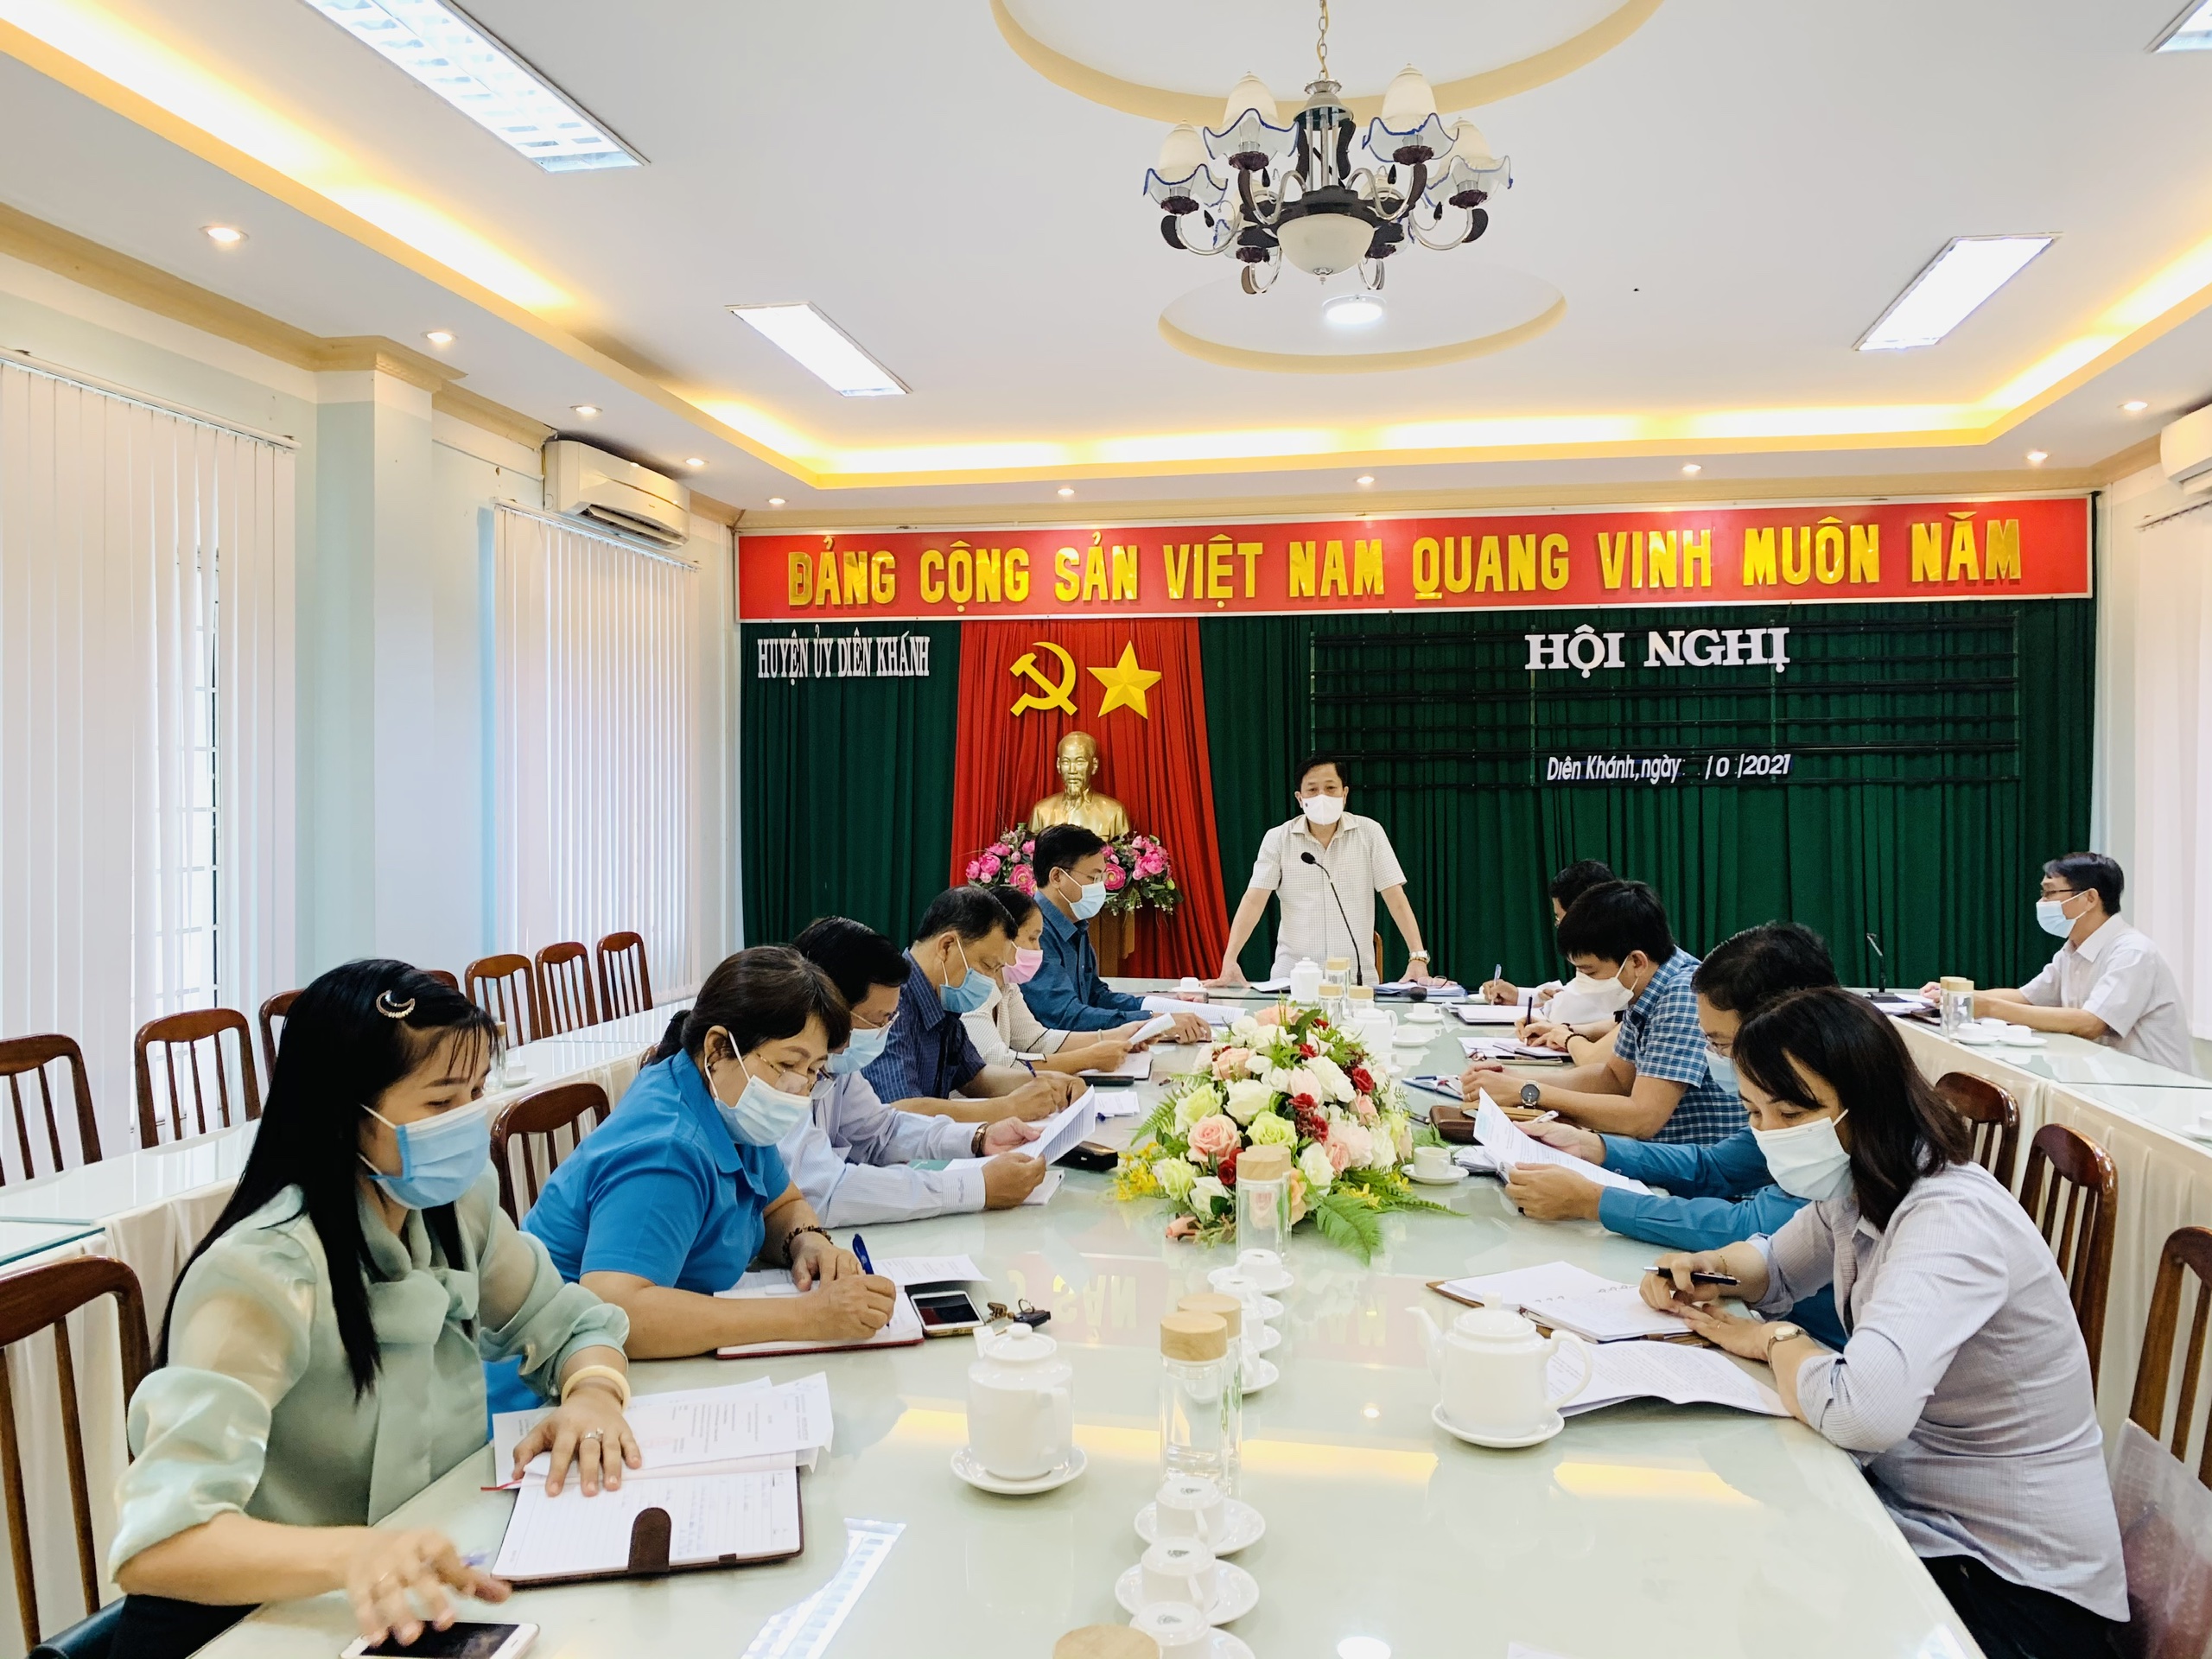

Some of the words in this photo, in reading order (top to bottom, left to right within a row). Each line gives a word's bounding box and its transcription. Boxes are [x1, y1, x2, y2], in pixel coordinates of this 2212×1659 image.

[787, 535, 896, 606] ĐẢNG
[919, 539, 1030, 613] CỘNG
[1053, 530, 1140, 603] SẢN
[1162, 532, 1264, 608] VIỆT
[1288, 537, 1385, 598] NAM
[1412, 532, 1570, 601] QUANG
[1597, 528, 1713, 590] VINH
[1742, 515, 1880, 586] MUÔN
[1910, 511, 2022, 582] NĂM
[757, 628, 810, 686] HUYỆN
[813, 623, 834, 679] ỦY
[836, 626, 873, 677] DIÊN
[875, 629, 931, 677] KHÁNH
[1524, 623, 1626, 679] HỘI
[1643, 626, 1791, 674] NGHỊ
